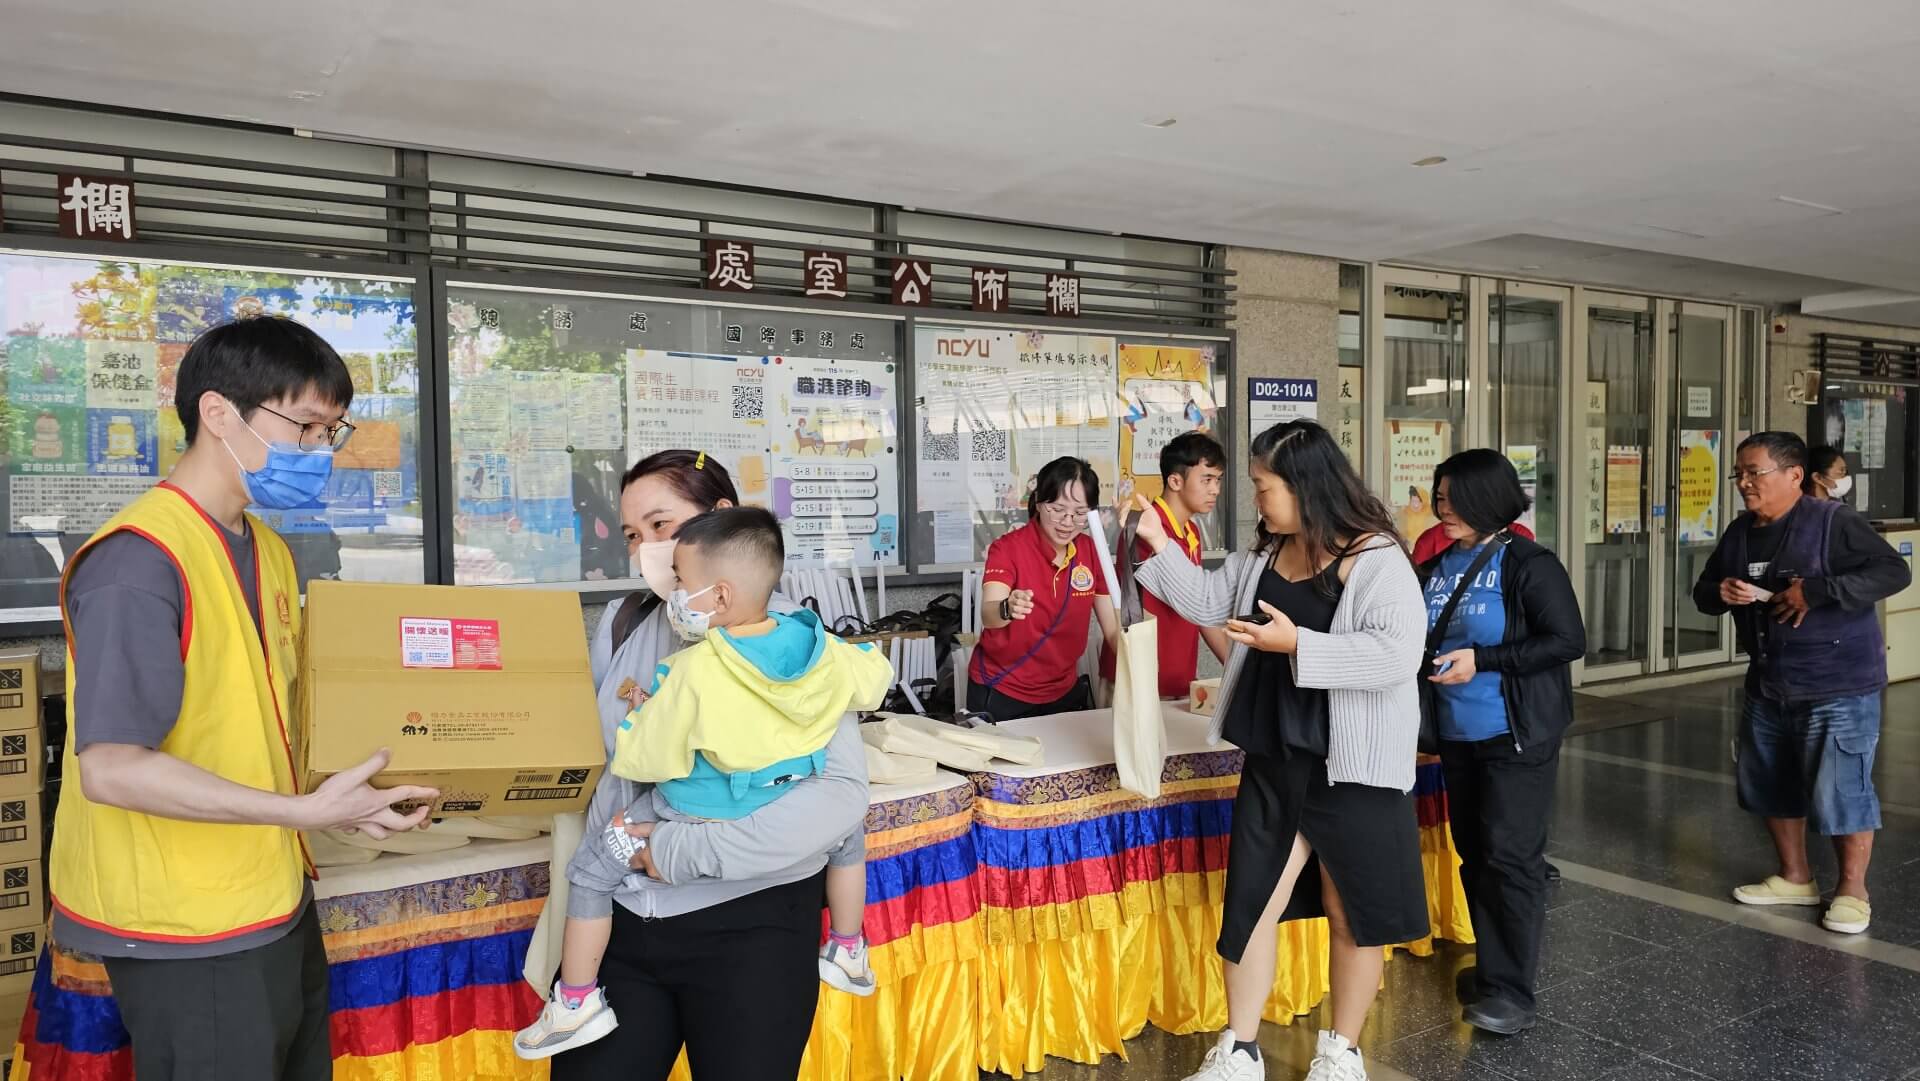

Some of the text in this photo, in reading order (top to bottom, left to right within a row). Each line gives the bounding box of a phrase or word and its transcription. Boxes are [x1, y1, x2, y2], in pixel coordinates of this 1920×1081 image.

[61, 176, 132, 239] 欄
[708, 241, 1079, 315] 處室公佈欄
[480, 308, 648, 333] 總務處
[726, 324, 865, 350] 國際事務處
[797, 376, 871, 397] 職涯諮詢
[1255, 382, 1313, 397] D02-101A
